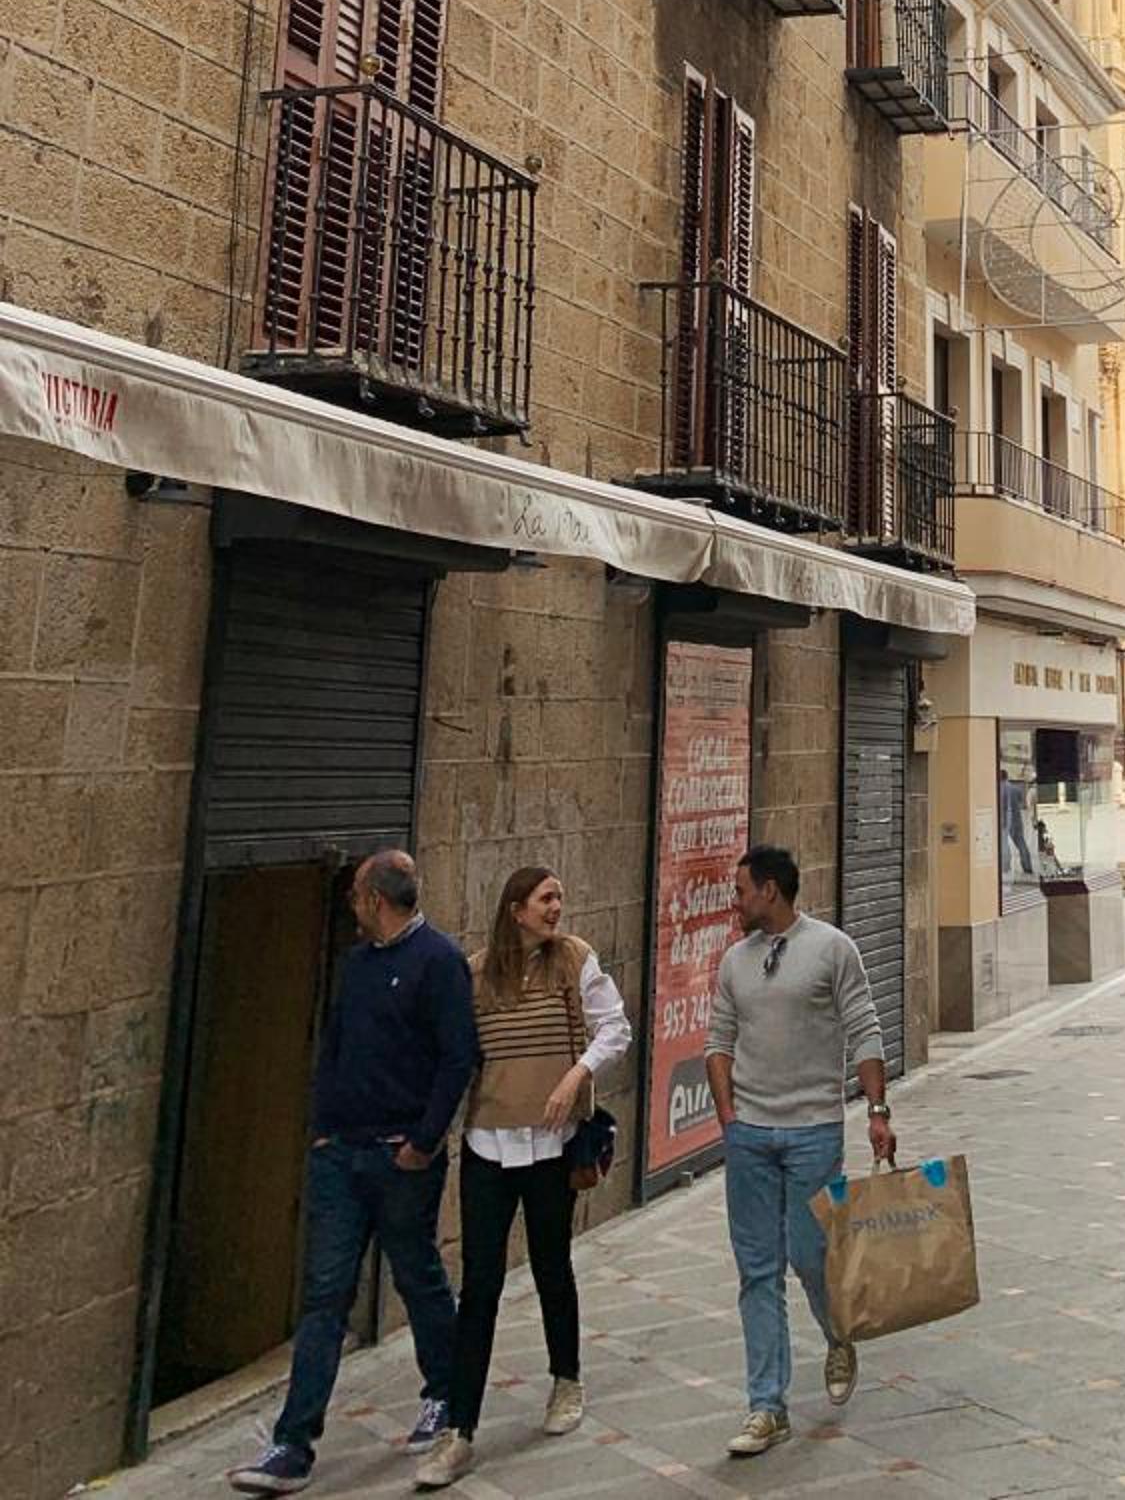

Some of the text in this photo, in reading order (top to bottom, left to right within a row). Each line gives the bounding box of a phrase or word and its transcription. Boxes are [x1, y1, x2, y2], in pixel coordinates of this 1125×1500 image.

[41, 371, 119, 432] VICTORIA
[688, 738, 729, 772] LOCAL
[669, 775, 746, 815] COMERCIAL
[663, 997, 687, 1041] 953
